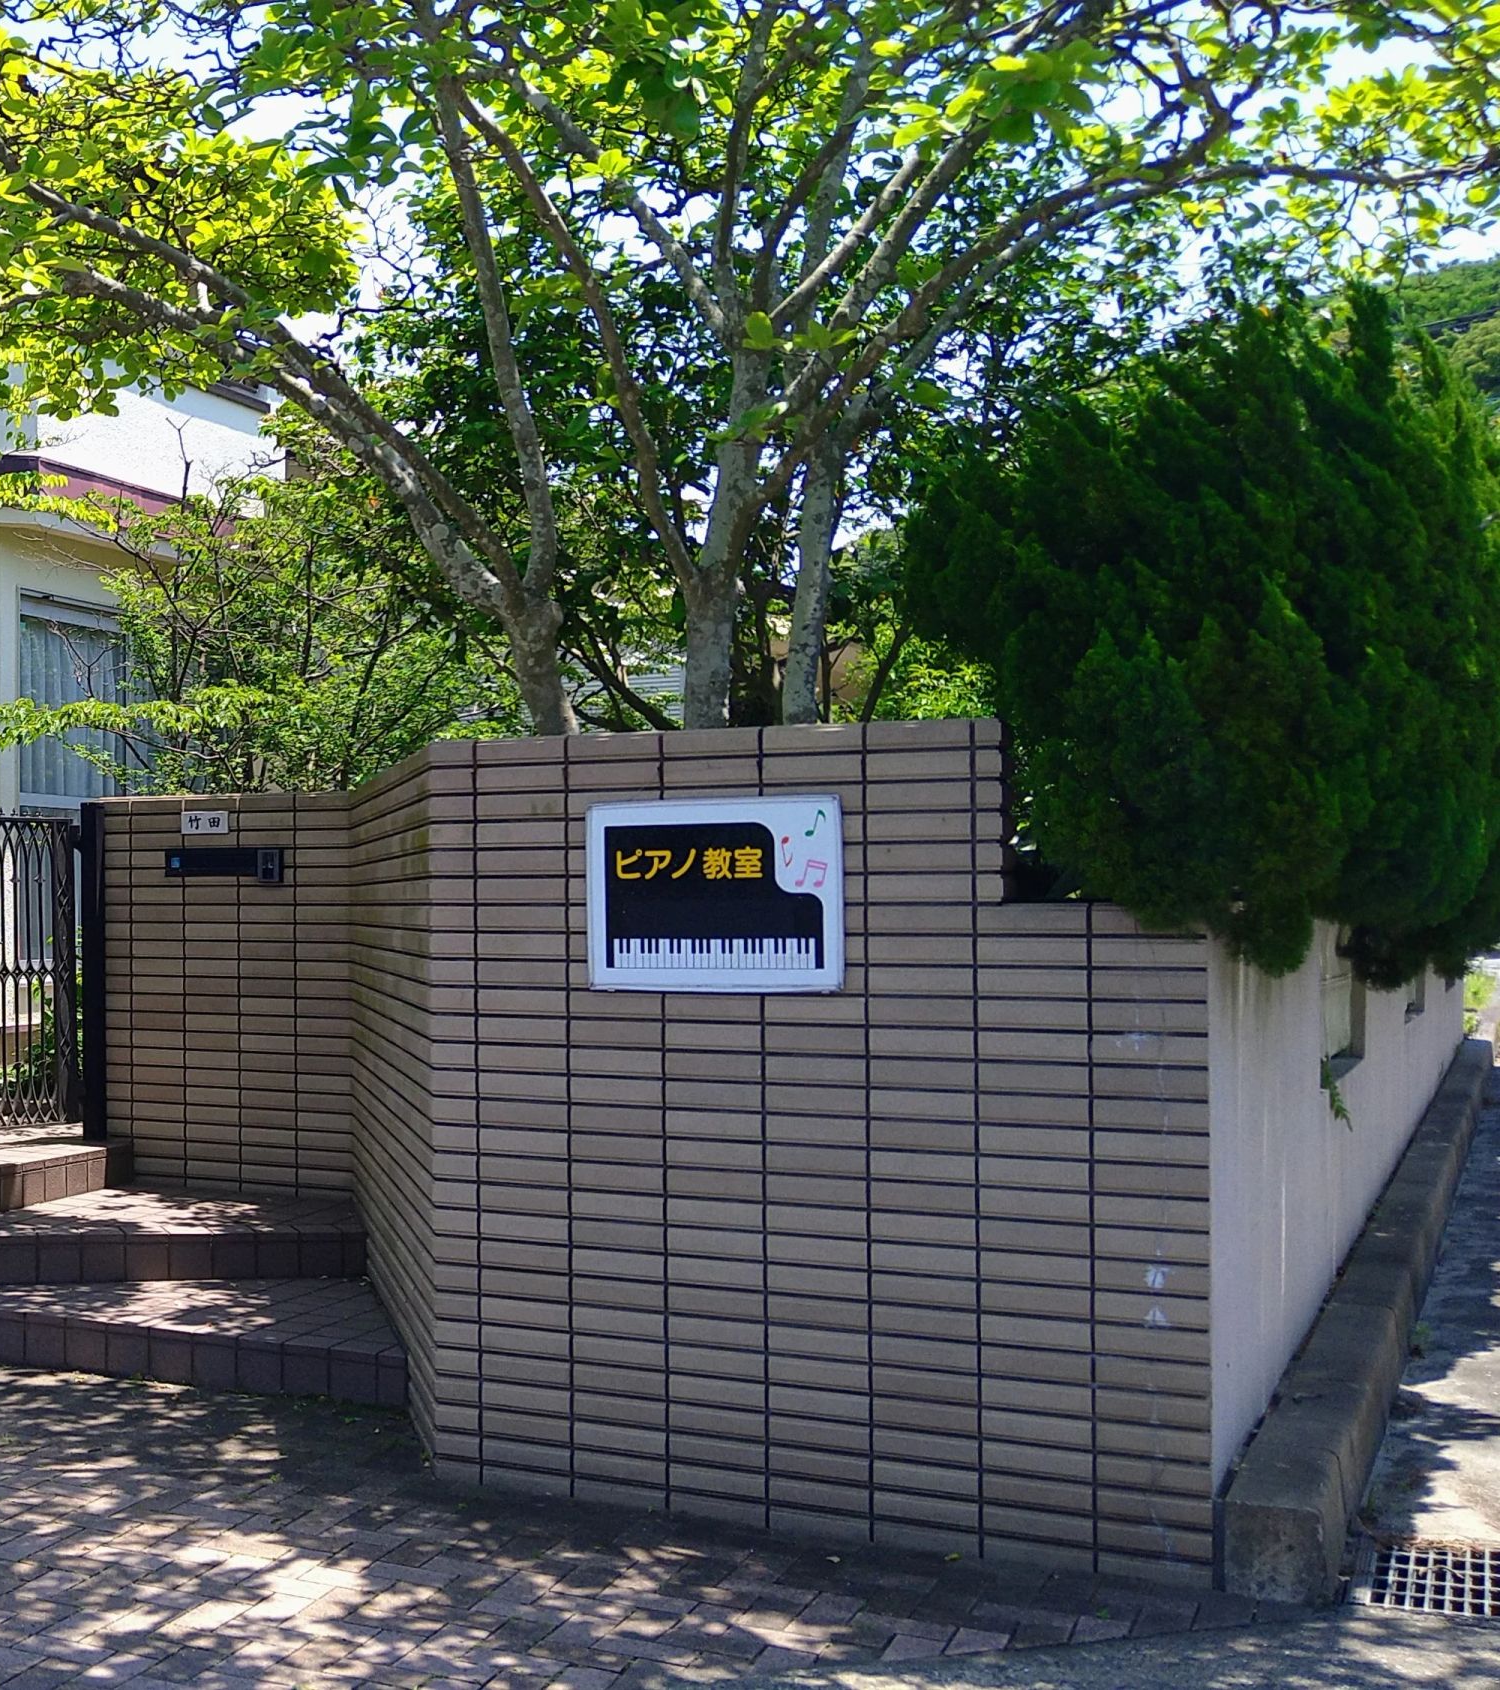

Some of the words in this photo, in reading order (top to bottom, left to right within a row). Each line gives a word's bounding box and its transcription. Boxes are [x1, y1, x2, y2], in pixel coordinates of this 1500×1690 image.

[188, 815, 221, 830] 竹田
[615, 846, 763, 880] ピアノ教室
